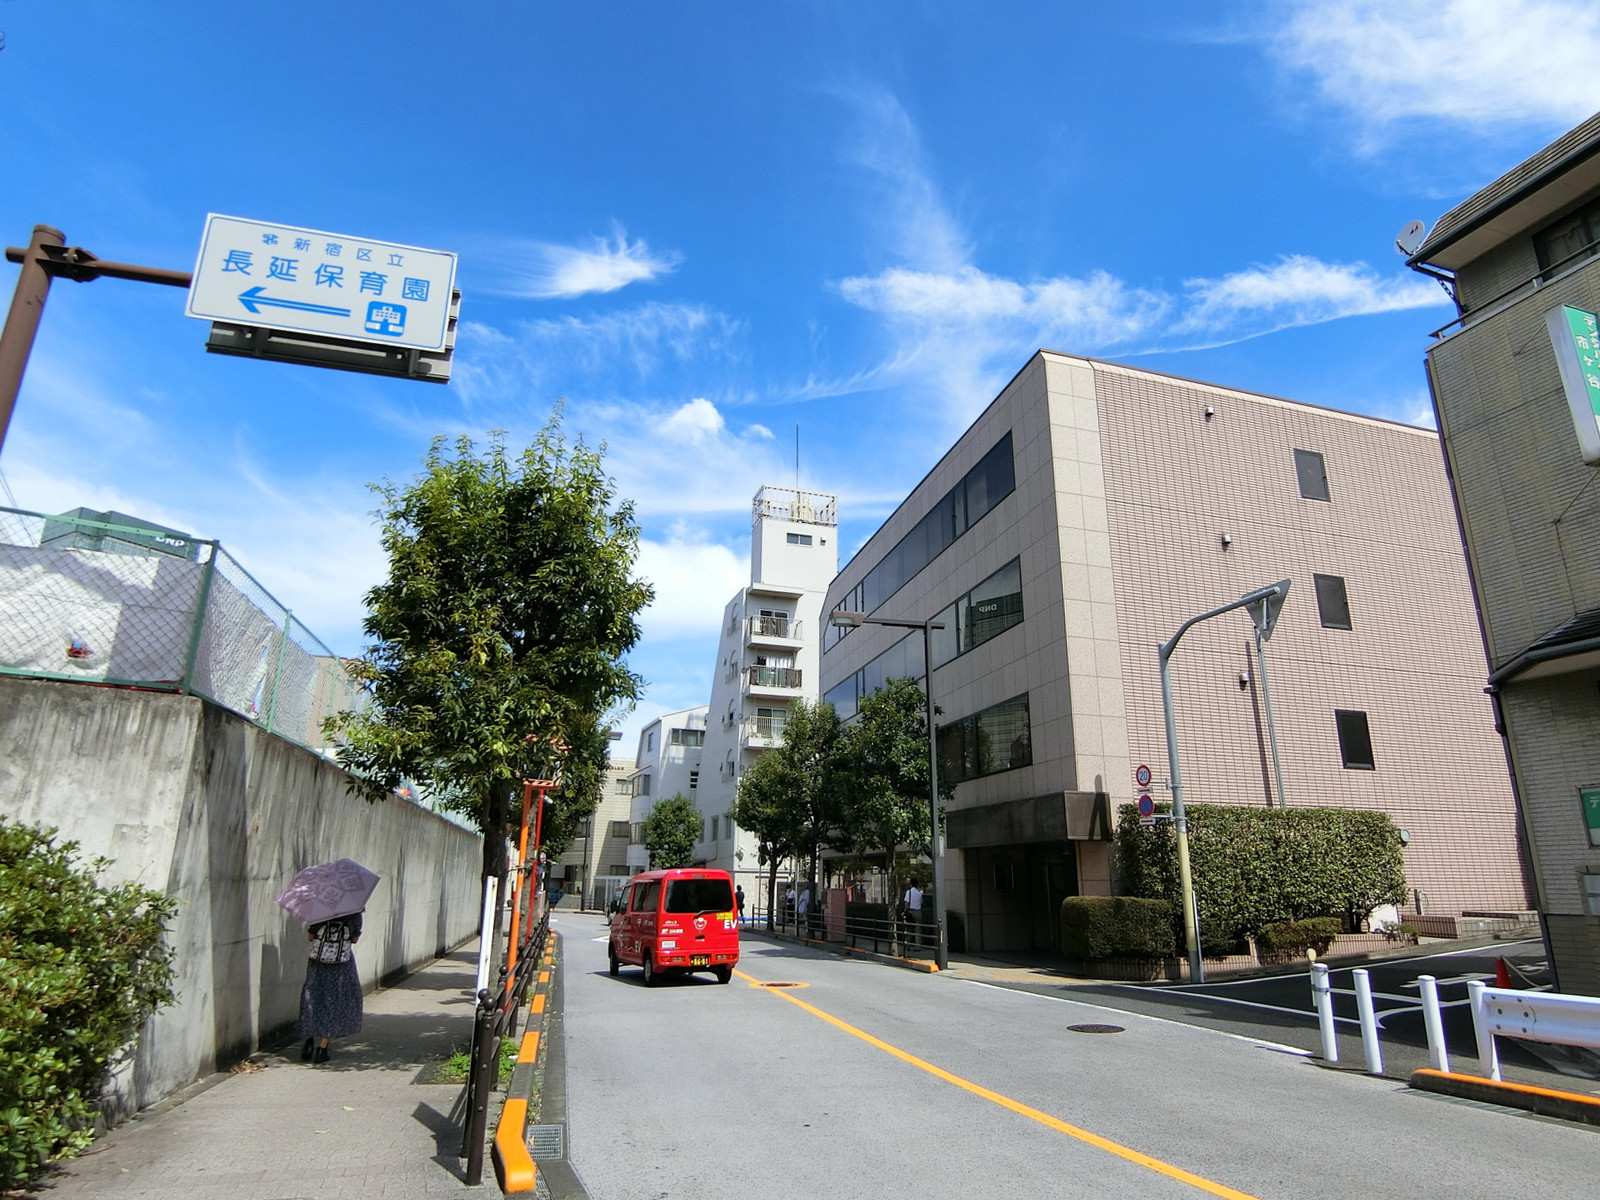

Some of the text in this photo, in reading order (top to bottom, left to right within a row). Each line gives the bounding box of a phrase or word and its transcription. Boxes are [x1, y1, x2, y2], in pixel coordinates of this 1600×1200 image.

[293, 237, 405, 268] 新宿区立
[221, 249, 431, 302] 長延保育園
[1140, 770, 1148, 781] 20
[724, 919, 738, 929] EV
[635, 940, 642, 953] EV
